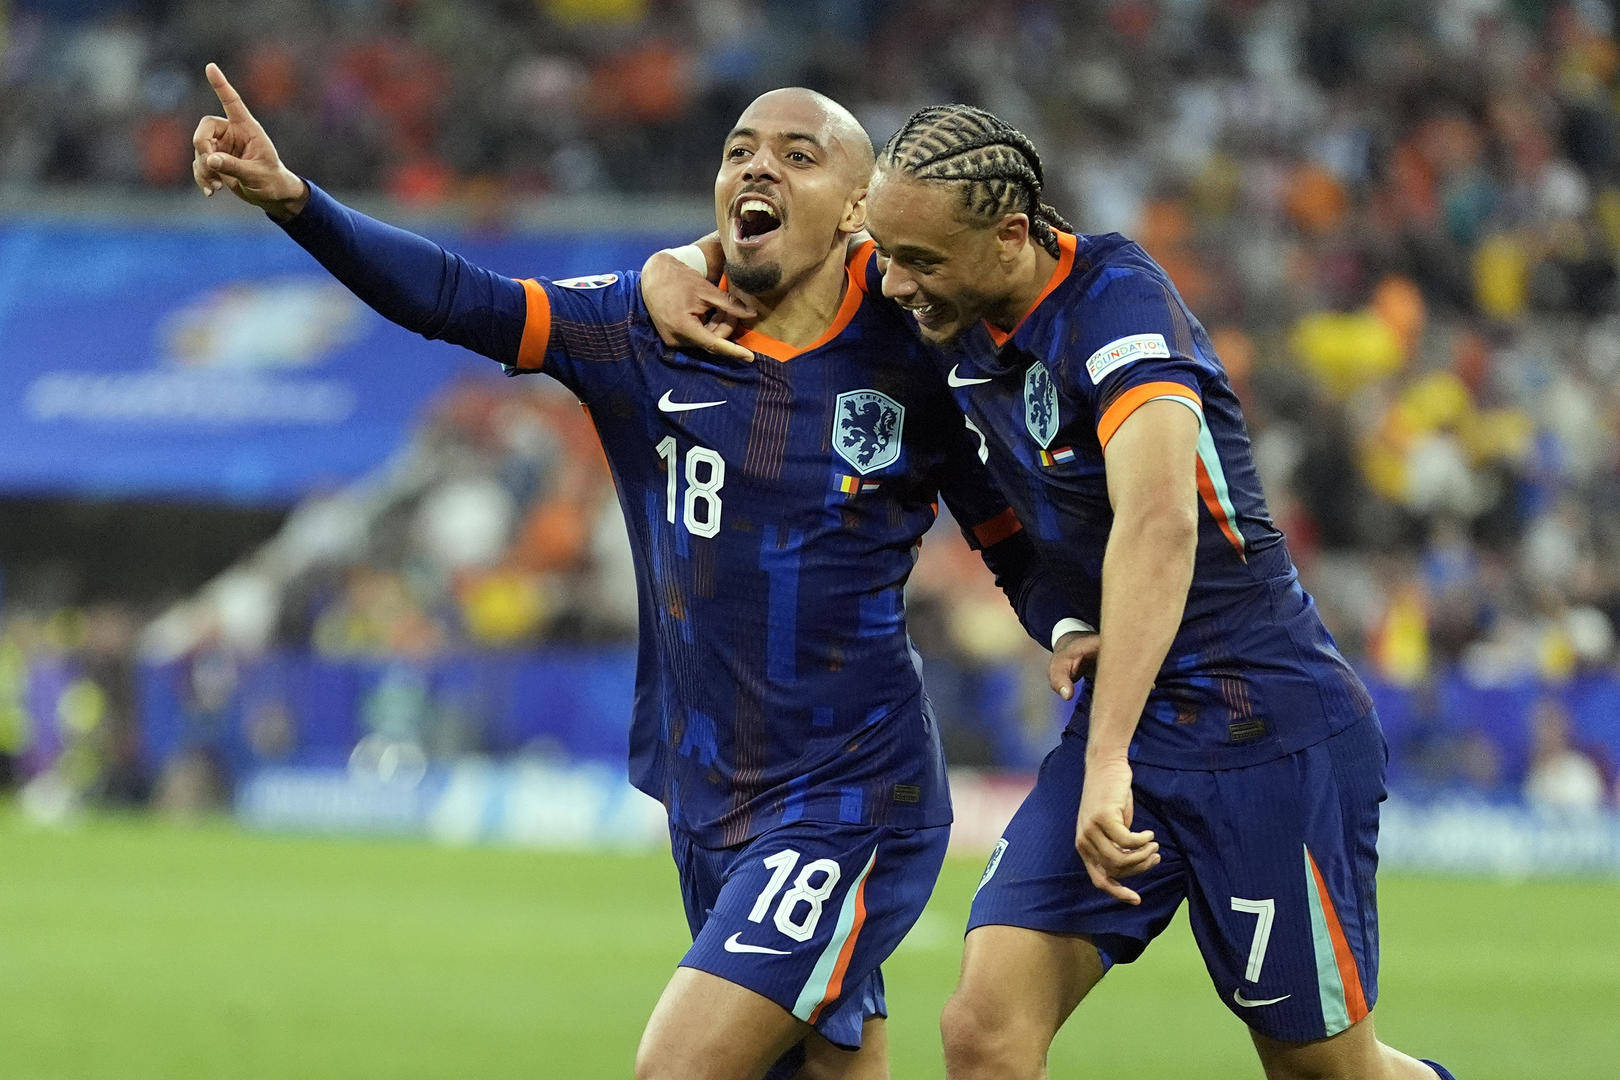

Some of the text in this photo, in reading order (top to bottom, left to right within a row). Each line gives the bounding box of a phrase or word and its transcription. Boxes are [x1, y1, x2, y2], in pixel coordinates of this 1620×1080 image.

[1090, 341, 1165, 374] FOUNDATION
[655, 434, 726, 539] 18
[747, 848, 841, 943] 18
[1230, 896, 1276, 983] 7
